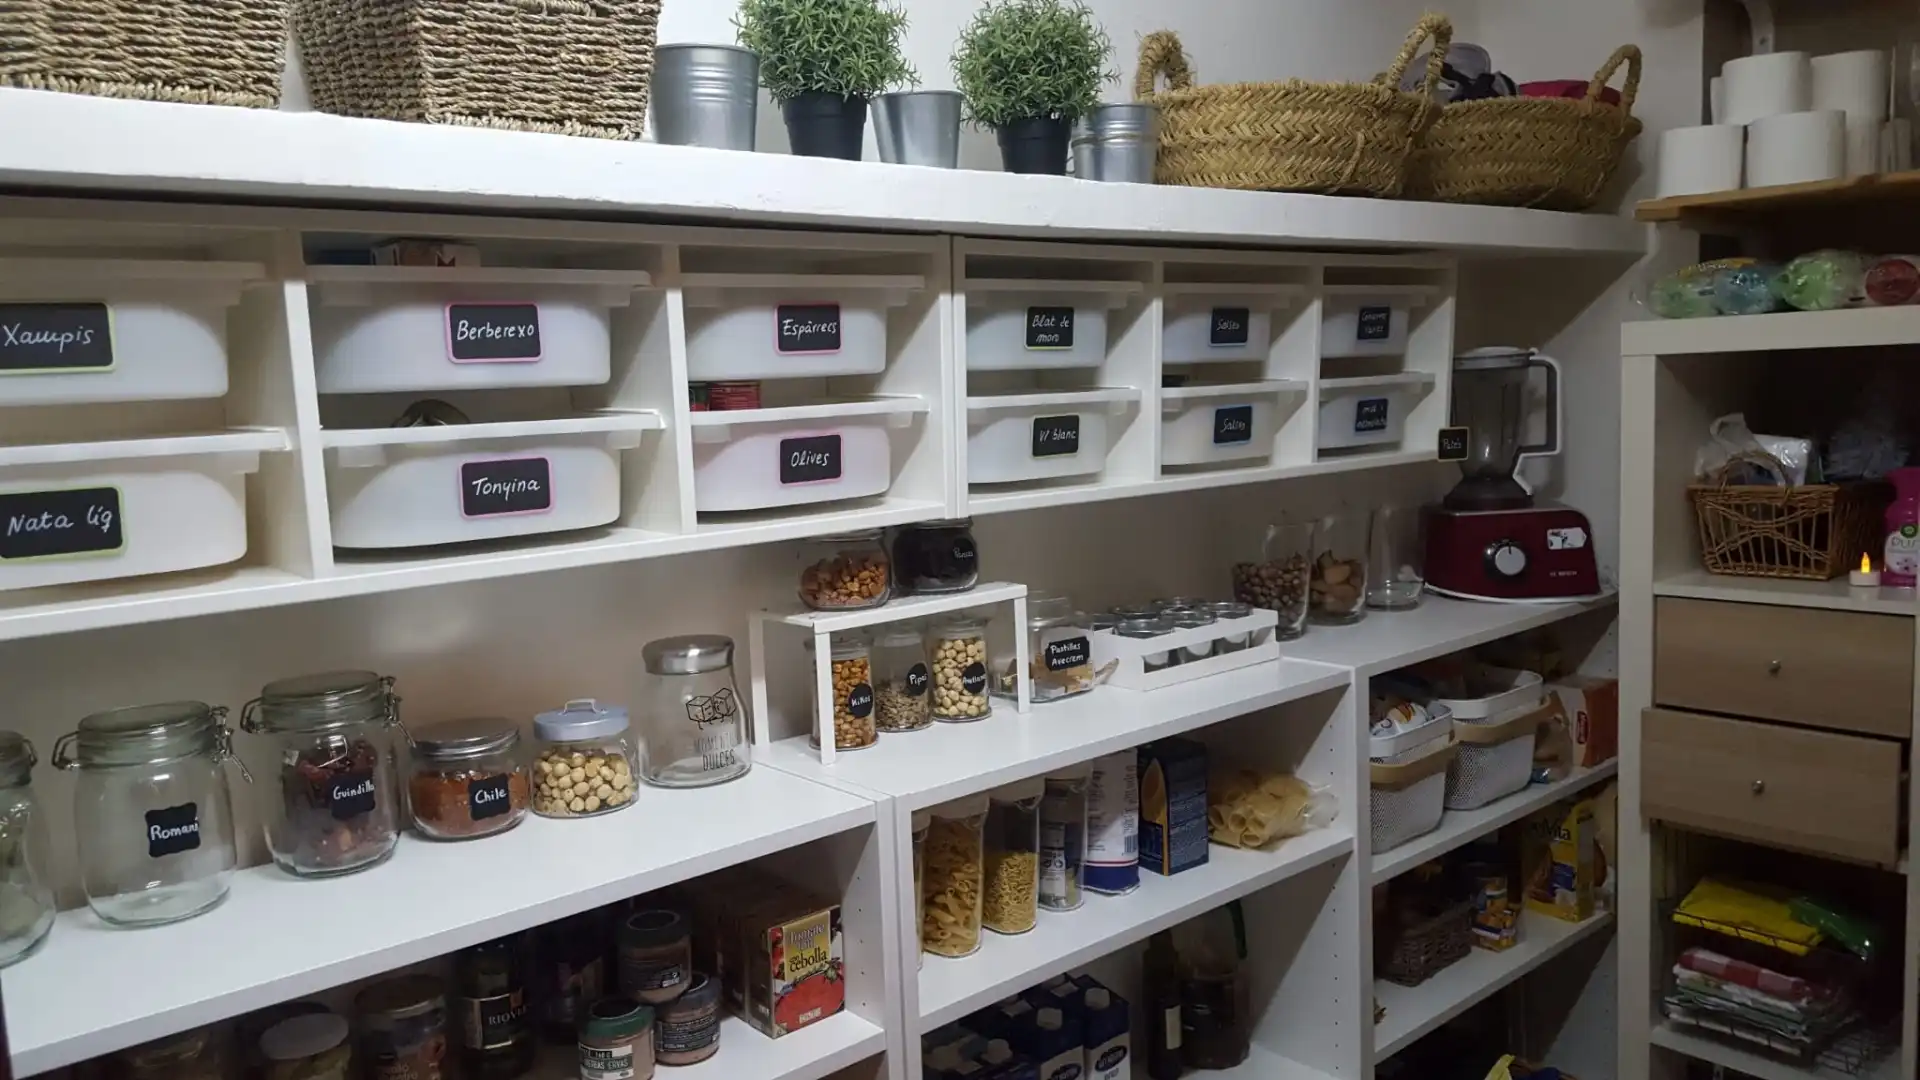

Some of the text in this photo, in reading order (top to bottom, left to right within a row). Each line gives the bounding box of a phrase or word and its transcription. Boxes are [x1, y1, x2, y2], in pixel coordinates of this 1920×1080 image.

[457, 319, 535, 341] Berberexo
[1032, 314, 1057, 328] Blat
[790, 450, 830, 468] Olives
[472, 476, 541, 501] Tonyina
[7, 511, 74, 536] Nata
[1051, 654, 1084, 667] Avecrem
[702, 748, 736, 772] DULCES
[475, 787, 508, 805] Chile
[790, 946, 828, 973] cebolla
